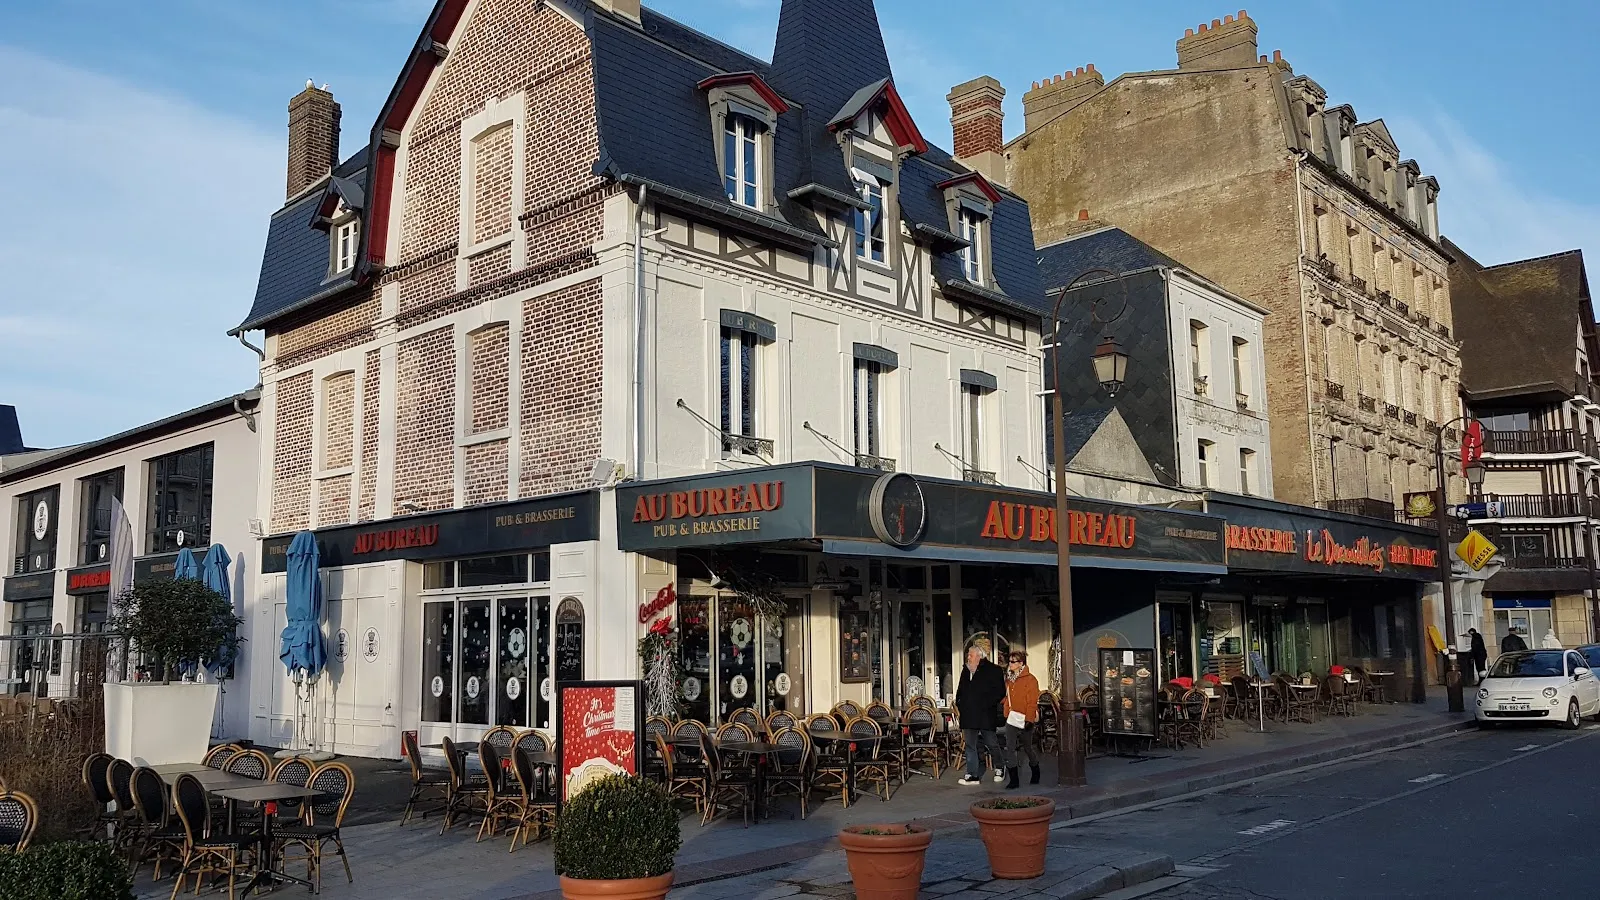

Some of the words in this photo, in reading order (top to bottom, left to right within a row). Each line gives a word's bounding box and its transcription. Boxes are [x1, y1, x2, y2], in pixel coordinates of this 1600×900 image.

[494, 515, 513, 527] PUB
[515, 513, 523, 525] &
[525, 506, 576, 524] BRASSERIE
[632, 493, 667, 523] AU
[671, 480, 784, 519] BUREAU
[653, 524, 677, 538] PUB
[679, 522, 690, 536] &
[693, 516, 761, 535] BRASSERIE
[981, 500, 1027, 541] AU
[352, 532, 376, 554] AU
[375, 523, 440, 552] BUREAU
[1224, 524, 1298, 554] BRASSERIE
[1472, 546, 1493, 568] PRESSE
